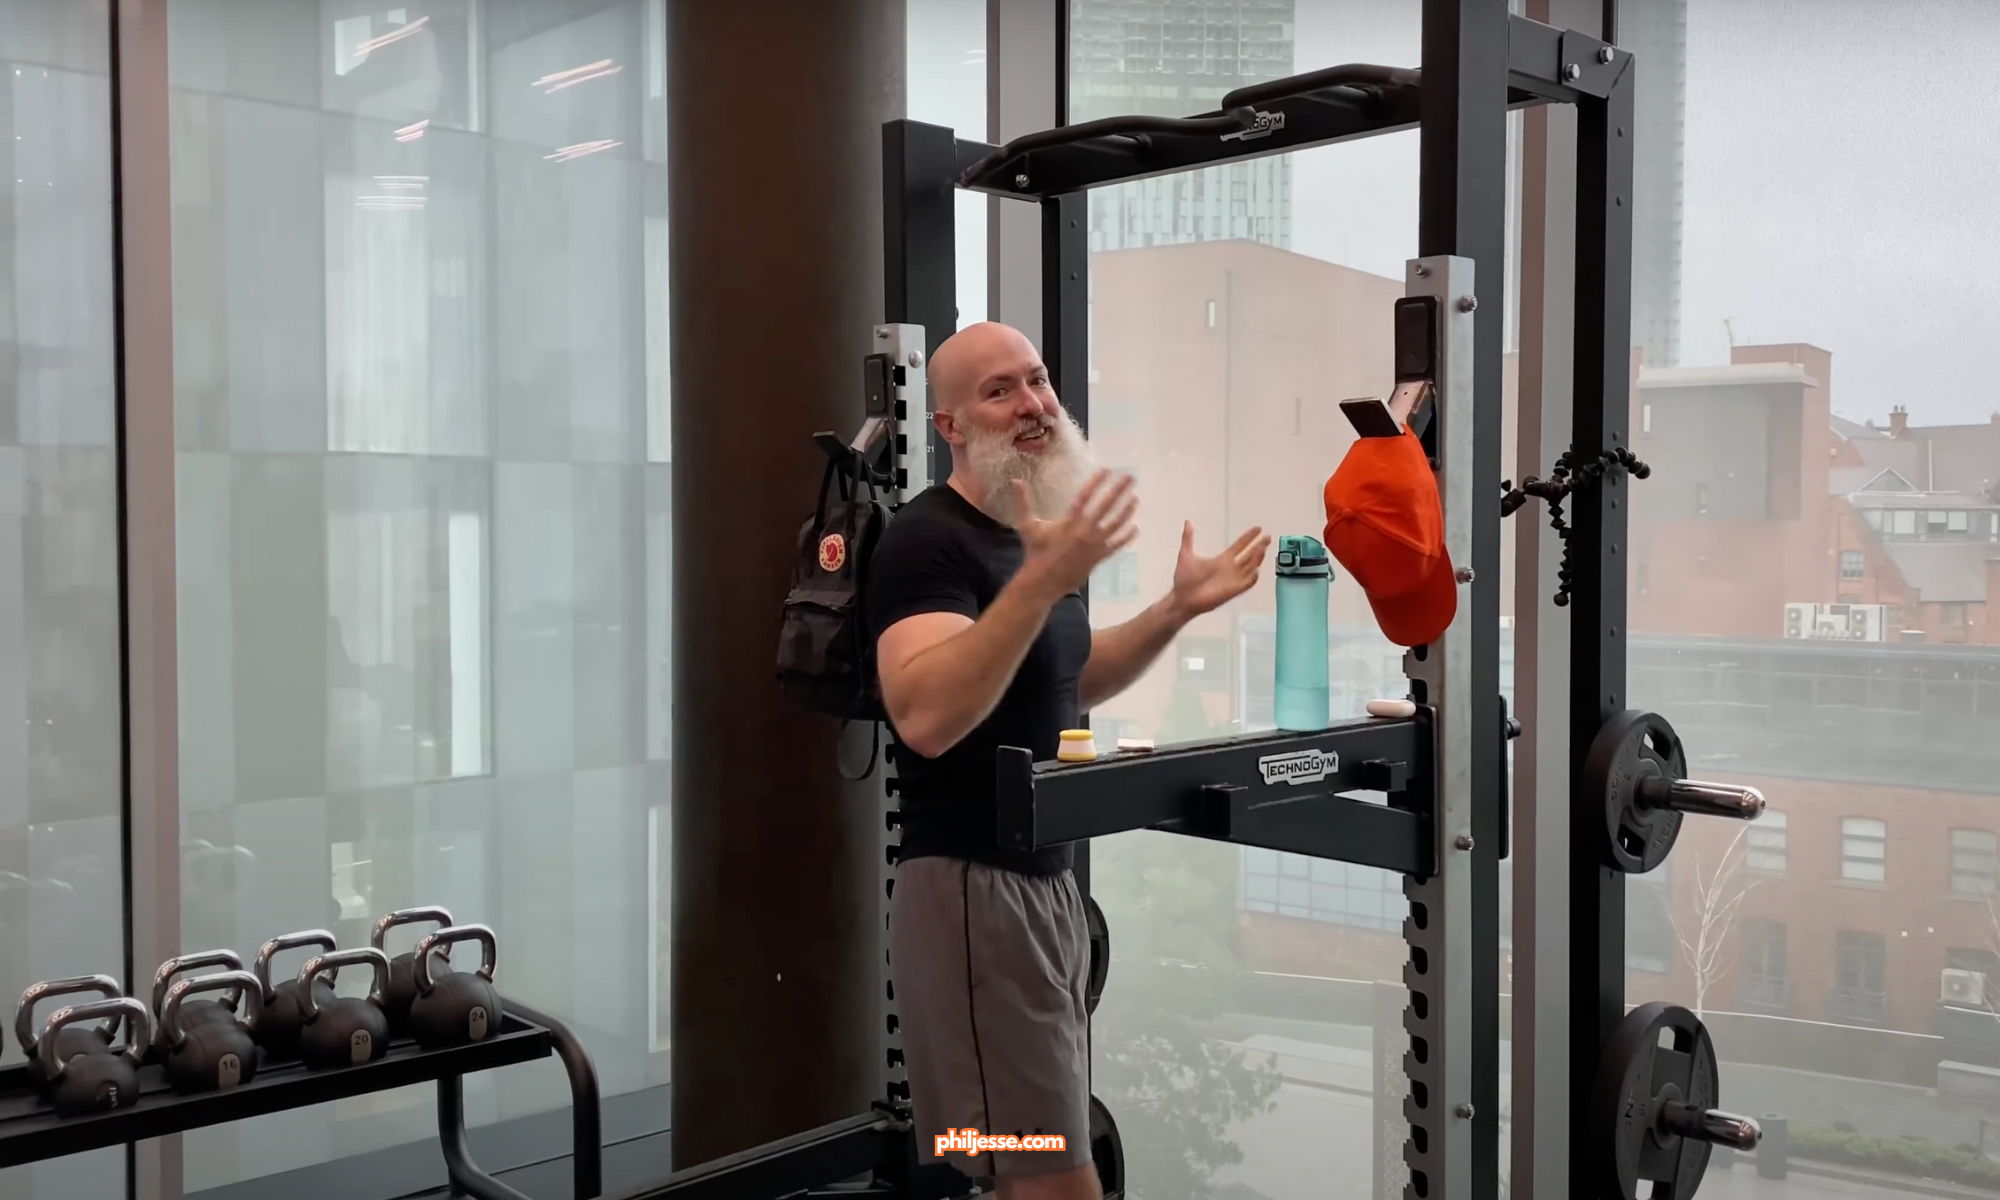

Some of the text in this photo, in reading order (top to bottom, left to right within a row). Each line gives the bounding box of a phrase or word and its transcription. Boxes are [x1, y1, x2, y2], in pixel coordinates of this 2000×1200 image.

[472, 1010, 485, 1022] 24
[354, 1034, 369, 1046] 20
[222, 1058, 237, 1070] 16
